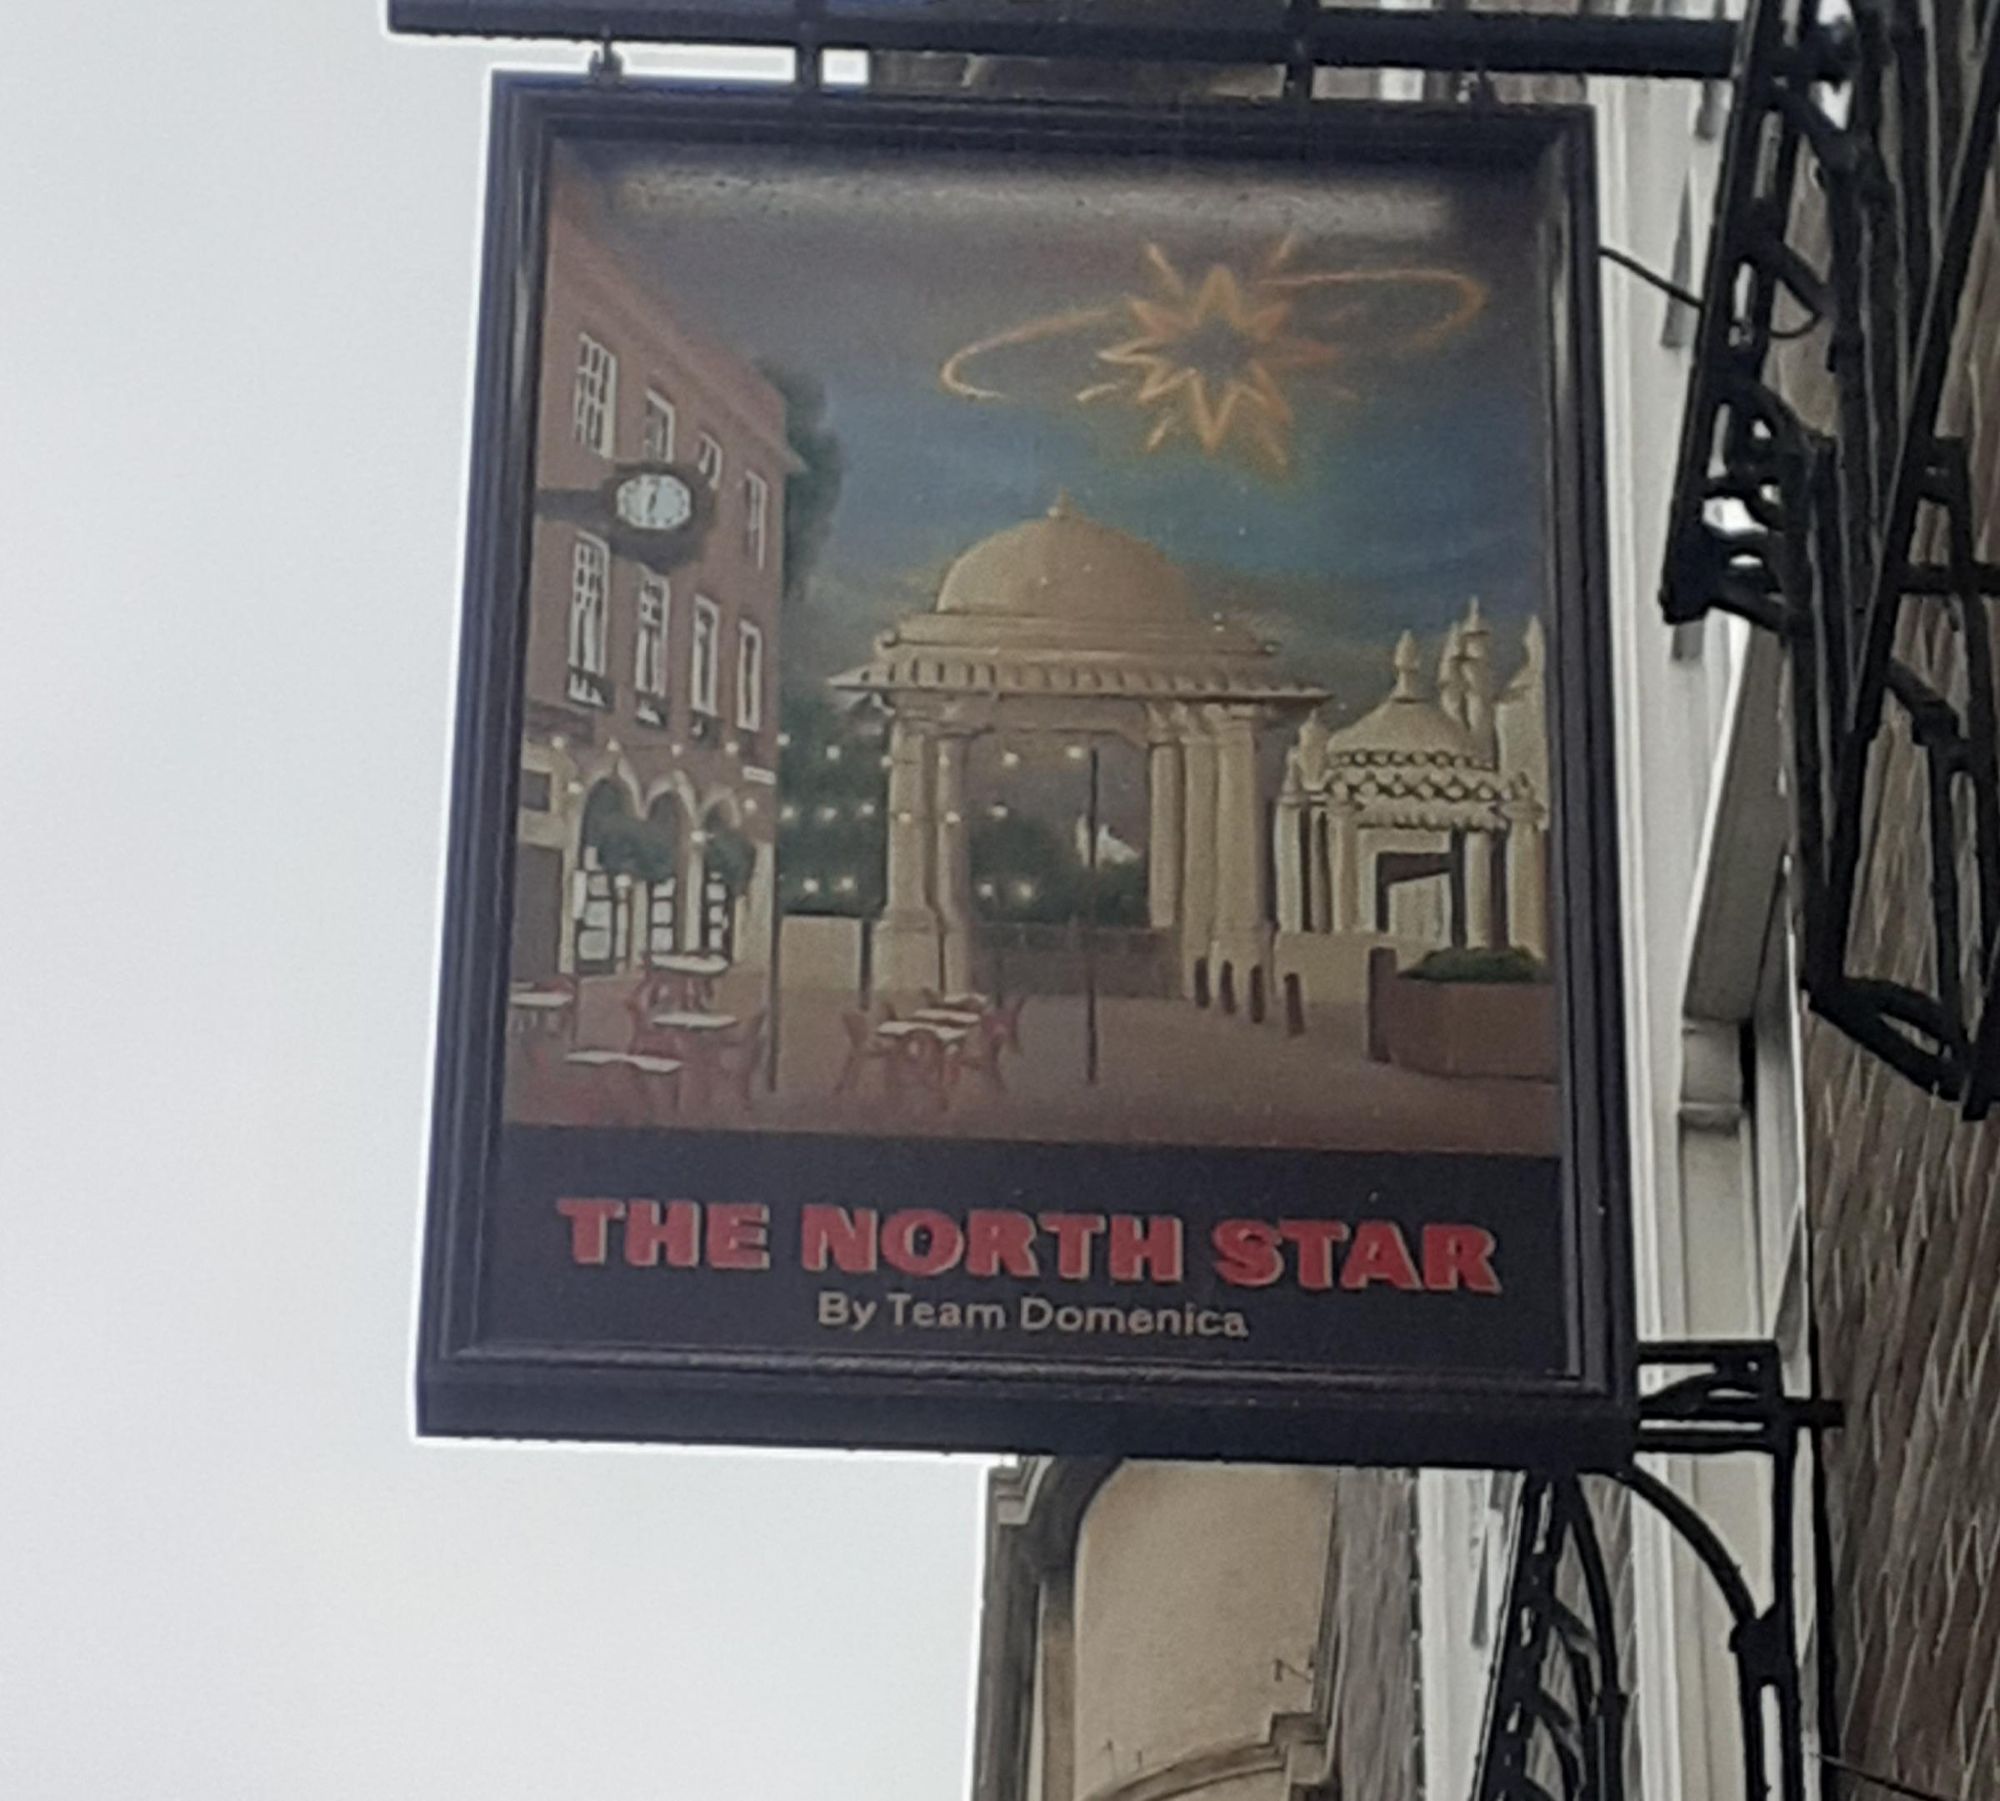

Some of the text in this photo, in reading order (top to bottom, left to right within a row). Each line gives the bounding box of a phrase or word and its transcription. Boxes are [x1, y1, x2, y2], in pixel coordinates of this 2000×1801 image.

[556, 1197, 1503, 1294] THE NORTH STAR
[817, 1291, 1249, 1338] By Team Domenica
